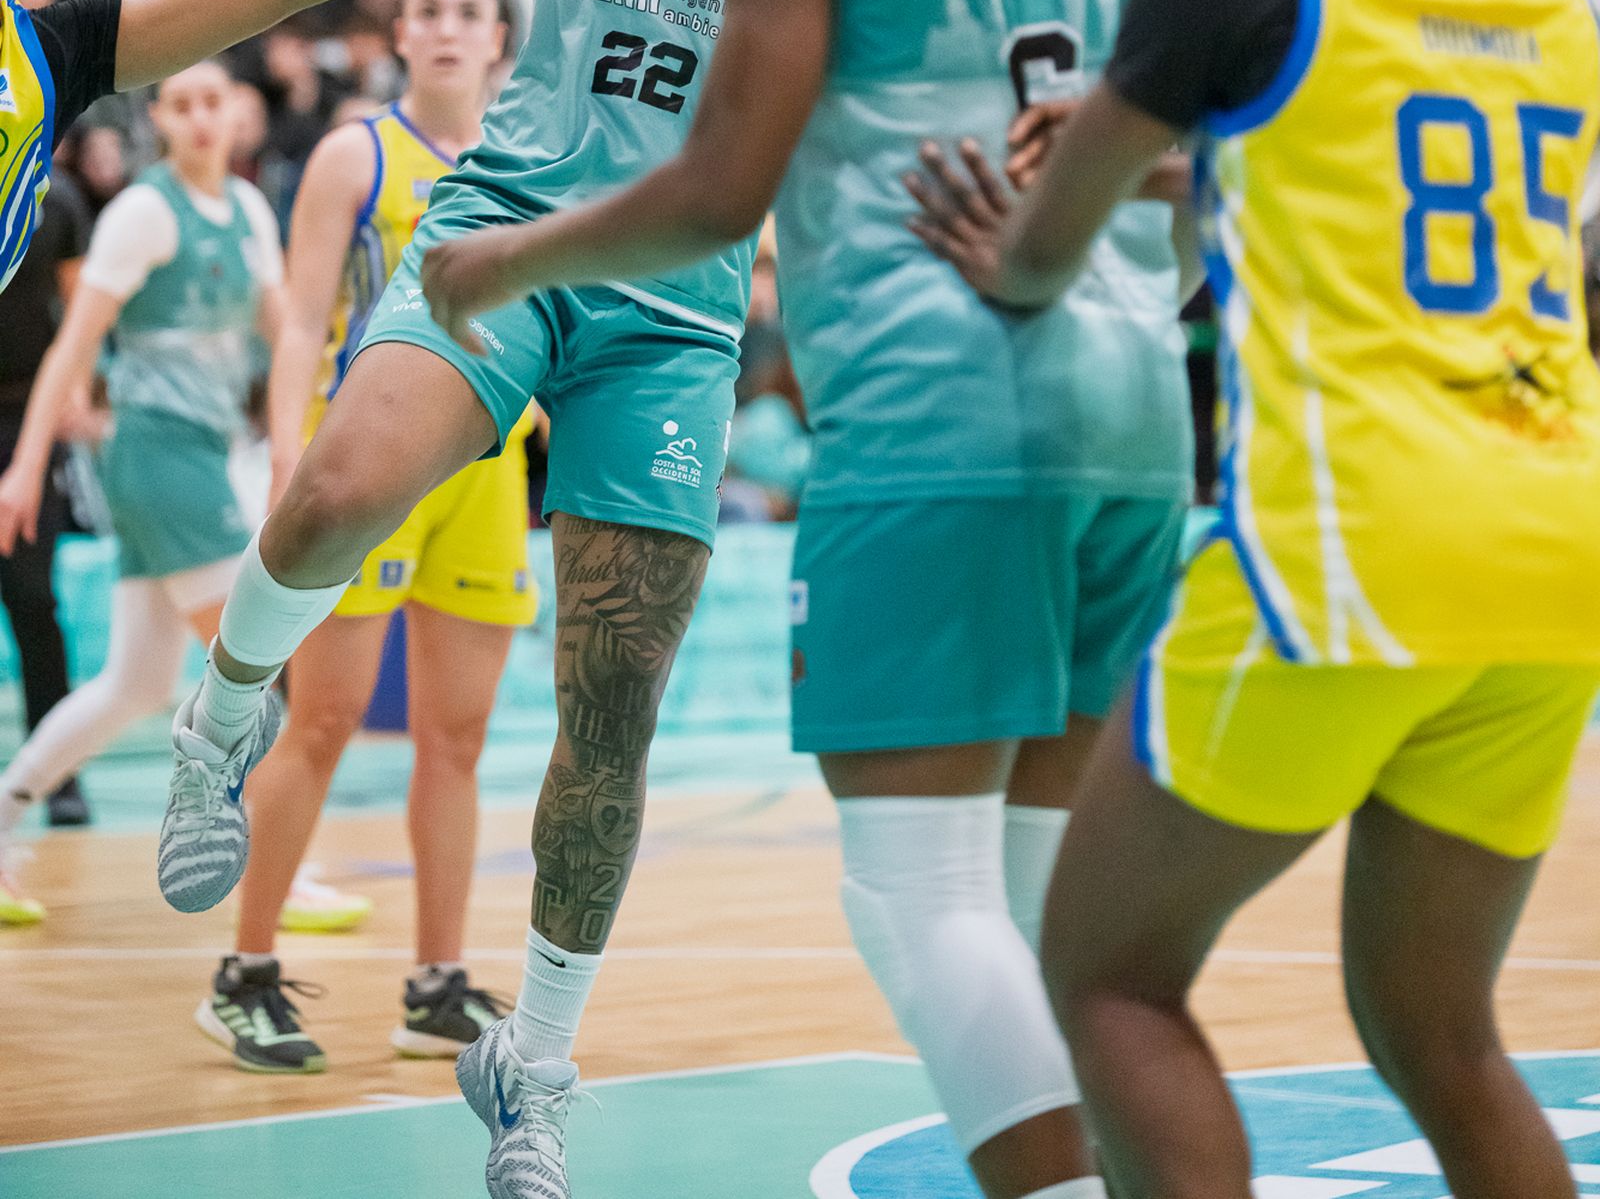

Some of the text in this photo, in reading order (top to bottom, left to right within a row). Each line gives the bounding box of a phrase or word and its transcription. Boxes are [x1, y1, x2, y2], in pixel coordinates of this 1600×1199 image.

[663, 8, 721, 40] ambie
[591, 30, 699, 115] 22
[1397, 91, 1586, 323] 85
[391, 300, 424, 314] vive
[468, 317, 506, 356] ospiten
[651, 465, 701, 485] OCCIDENTAL
[653, 458, 702, 477] COSTA DEL SOL
[557, 534, 618, 586] Christ
[601, 804, 638, 838] 95
[535, 823, 563, 861] 22
